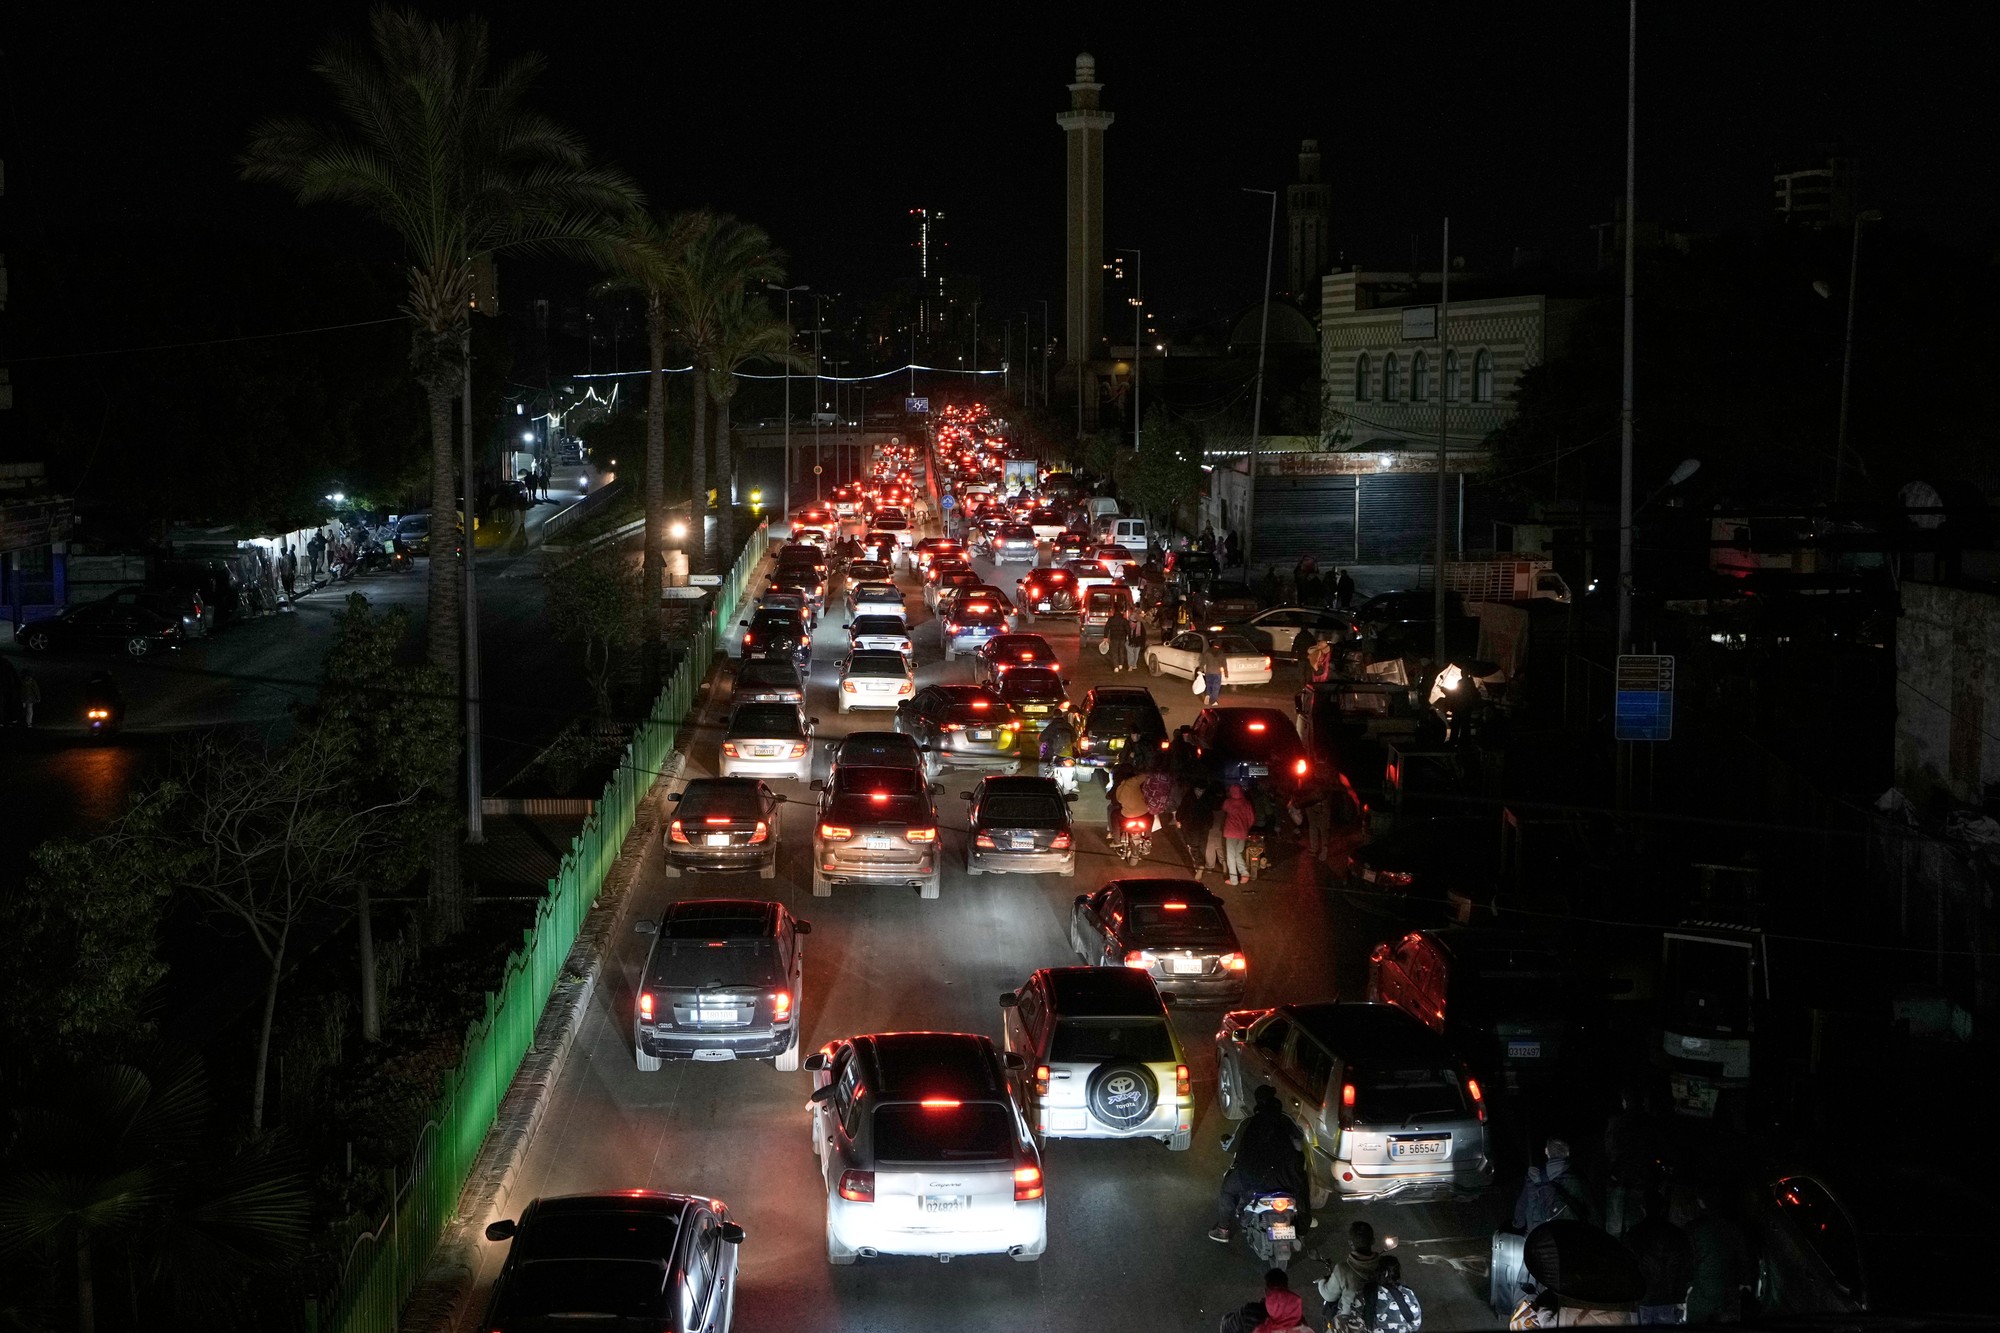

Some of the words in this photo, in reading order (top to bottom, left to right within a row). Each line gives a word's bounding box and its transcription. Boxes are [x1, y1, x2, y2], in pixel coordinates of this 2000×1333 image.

[1508, 1047, 1540, 1056] 0312497
[1115, 1102, 1136, 1110] TOYOTA
[1399, 1144, 1405, 1155] B
[1409, 1142, 1440, 1154] 565547
